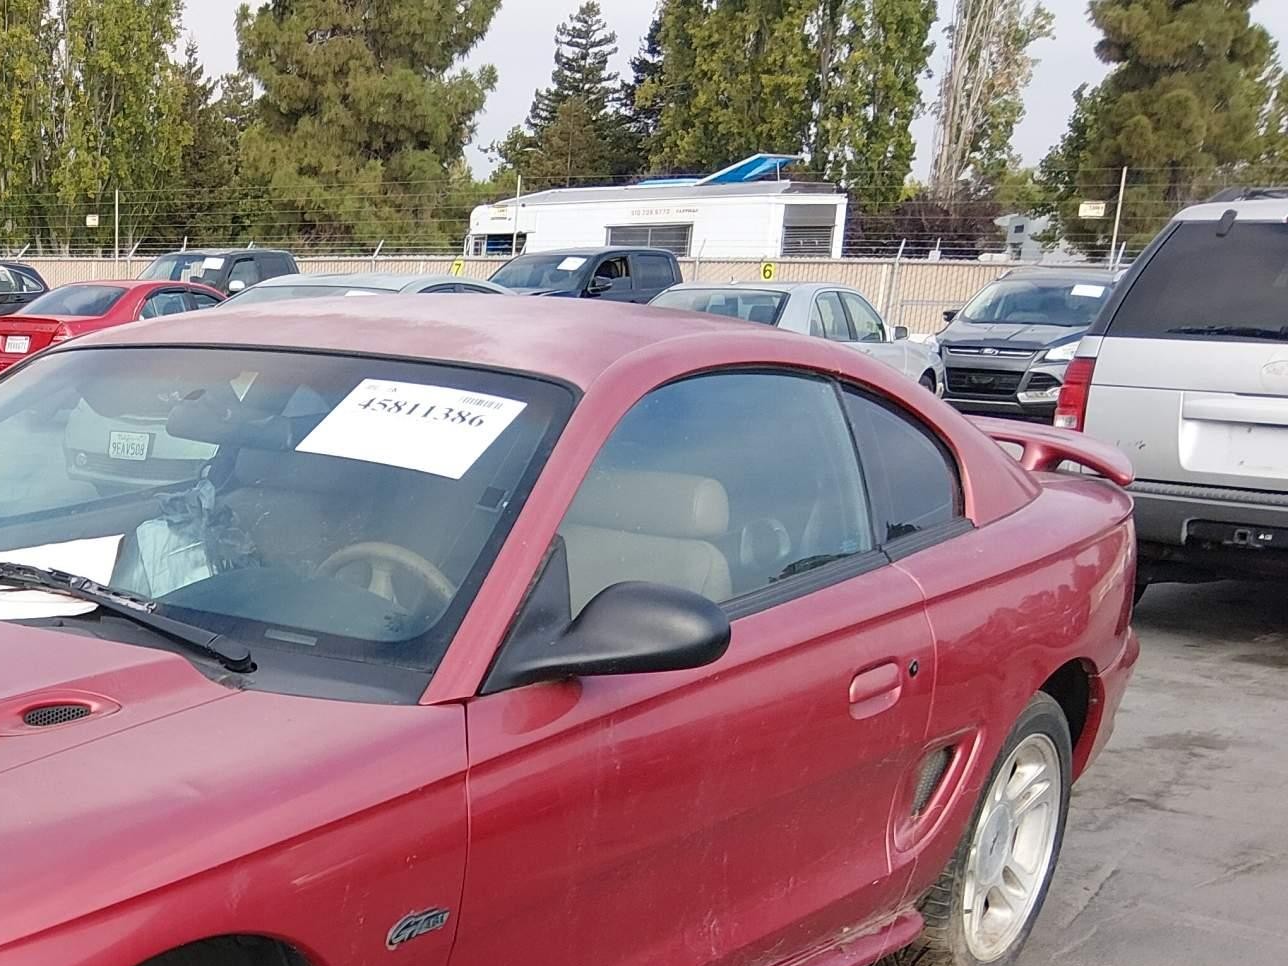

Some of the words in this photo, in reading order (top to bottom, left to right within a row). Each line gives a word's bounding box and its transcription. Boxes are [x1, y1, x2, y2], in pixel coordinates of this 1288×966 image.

[454, 262, 462, 277] 7
[762, 263, 772, 279] 6
[358, 397, 485, 427] 45811386
